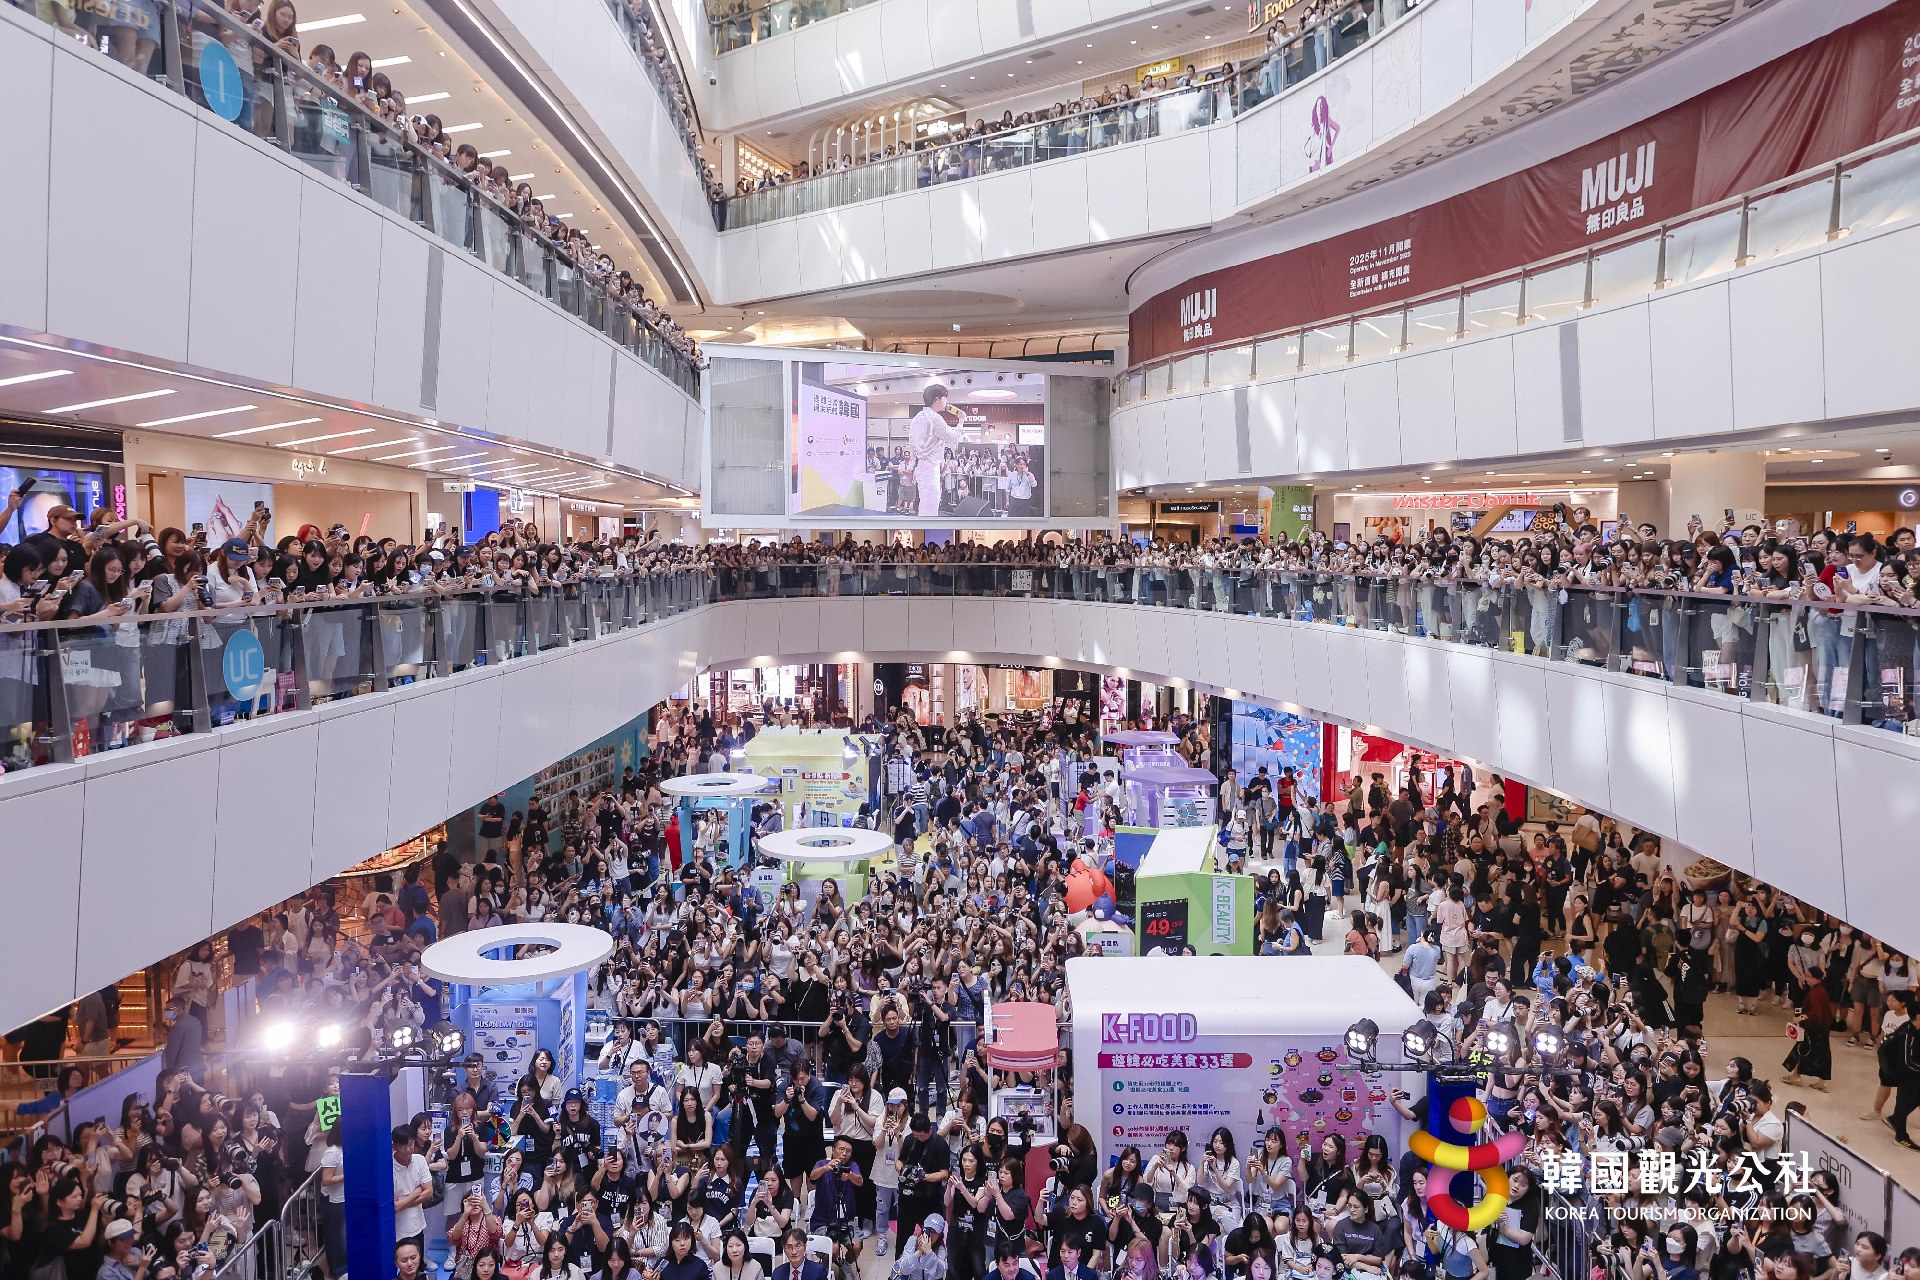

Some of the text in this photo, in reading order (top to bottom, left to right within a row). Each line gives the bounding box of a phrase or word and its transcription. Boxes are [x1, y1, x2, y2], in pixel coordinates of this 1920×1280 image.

[1581, 140, 1656, 213] MUJI
[1586, 195, 1645, 236] 無印良品
[1349, 263, 1369, 275] Opening
[1375, 254, 1399, 267] November
[1399, 250, 1412, 260] 2025
[1387, 280, 1398, 288] New
[1398, 276, 1410, 285] Look
[1180, 288, 1217, 328] MUJI
[1745, 513, 1757, 521] UC
[229, 647, 259, 683] UC
[1145, 918, 1170, 936] 49
[474, 1020, 534, 1029] BUSAN DAY TOUR
[1101, 1012, 1197, 1043] K-FOOD
[1111, 1053, 1235, 1070] 遊韓必吃美食33選
[321, 1098, 340, 1127] 성
